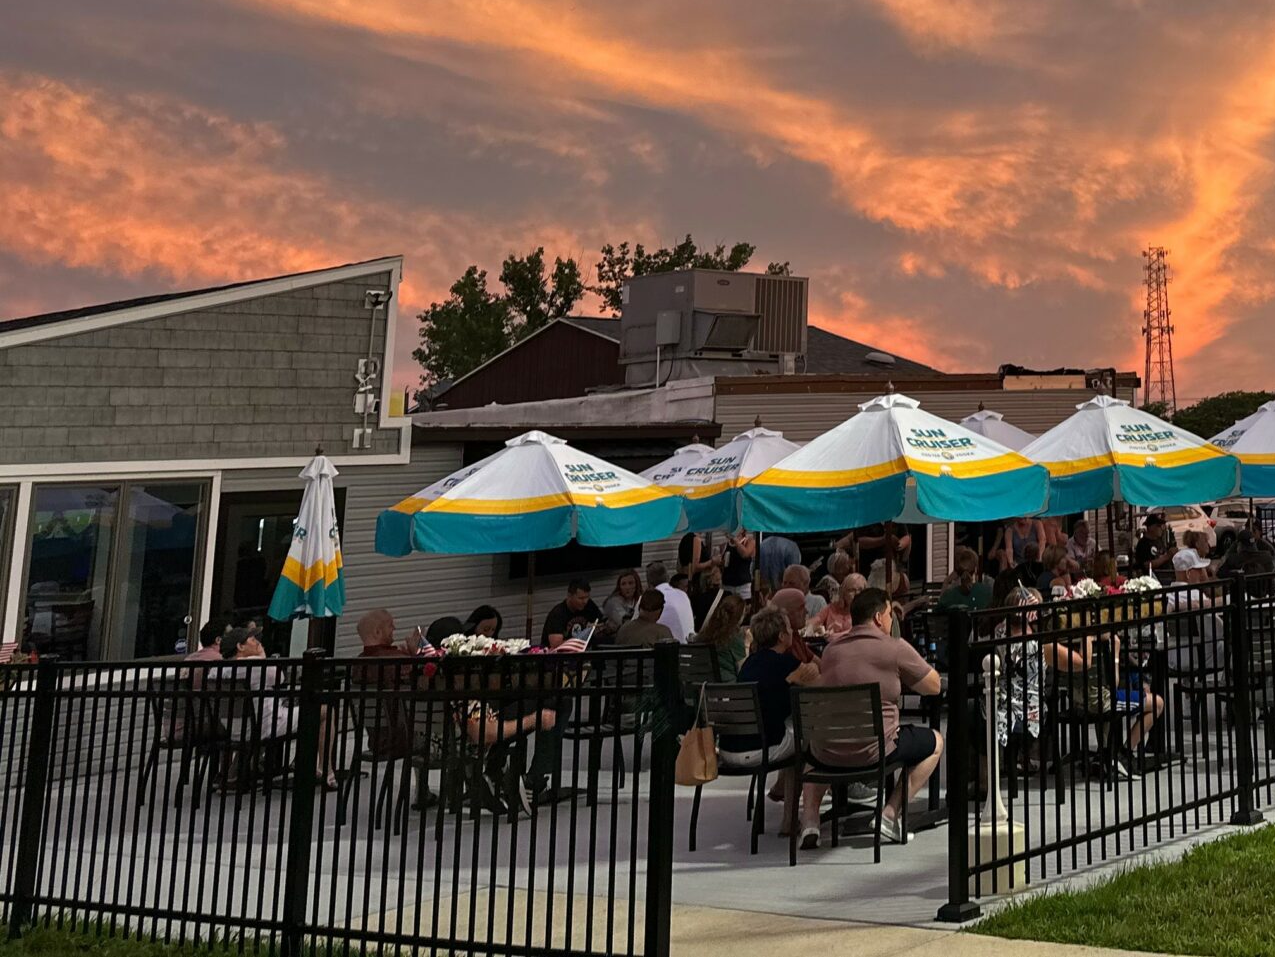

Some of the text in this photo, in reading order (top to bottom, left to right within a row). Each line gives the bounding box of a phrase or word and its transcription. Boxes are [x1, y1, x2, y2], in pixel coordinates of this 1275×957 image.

[909, 428, 946, 438] SUN
[1120, 423, 1152, 433] SUN
[1115, 430, 1176, 442] CRUISER
[906, 437, 974, 449] CRUISER
[708, 456, 737, 466] SUN
[564, 463, 594, 473] SUN
[685, 463, 740, 476] CRUISER
